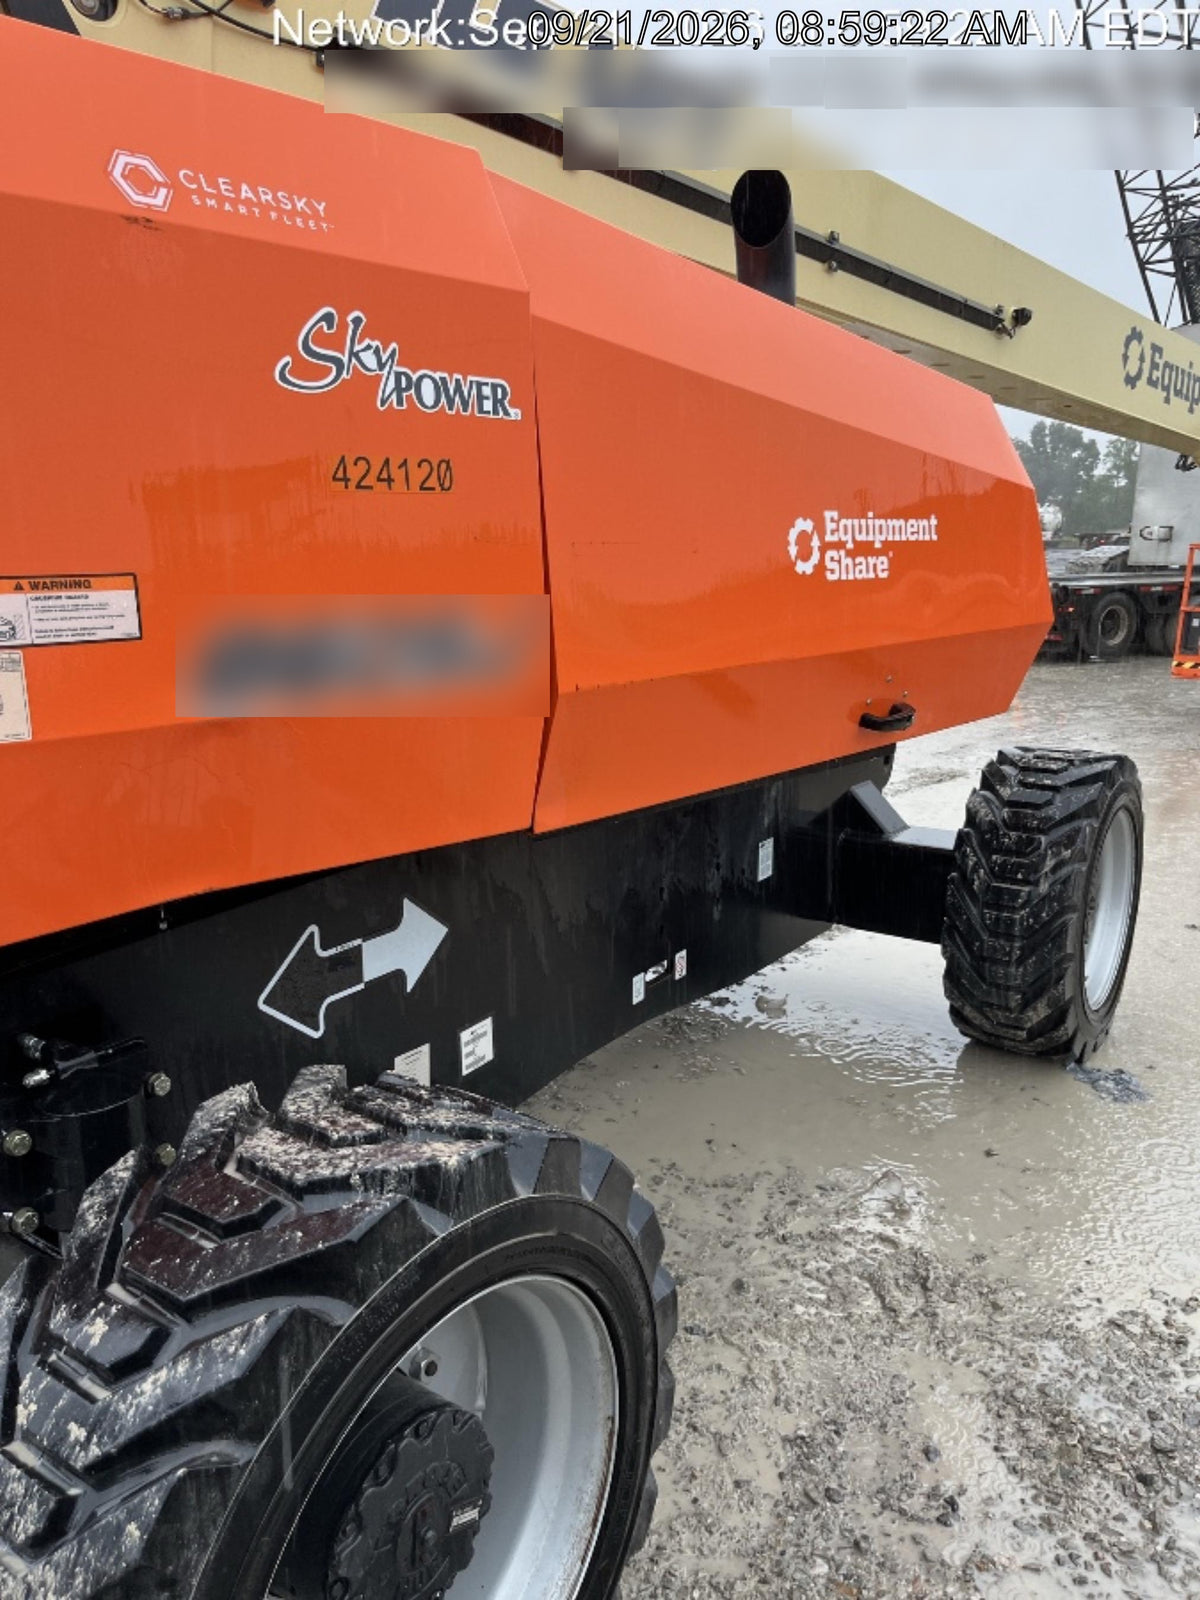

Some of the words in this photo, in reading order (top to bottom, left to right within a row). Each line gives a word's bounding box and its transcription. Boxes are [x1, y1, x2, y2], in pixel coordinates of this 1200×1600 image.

[179, 169, 327, 217] CLEARSKY
[191, 194, 261, 219] SMART
[270, 210, 329, 232] FLEET
[275, 308, 398, 410] Sky
[332, 455, 453, 491] 424120
[823, 509, 938, 549] Equipment
[824, 549, 890, 581] Share
[28, 578, 92, 592] WARNING
